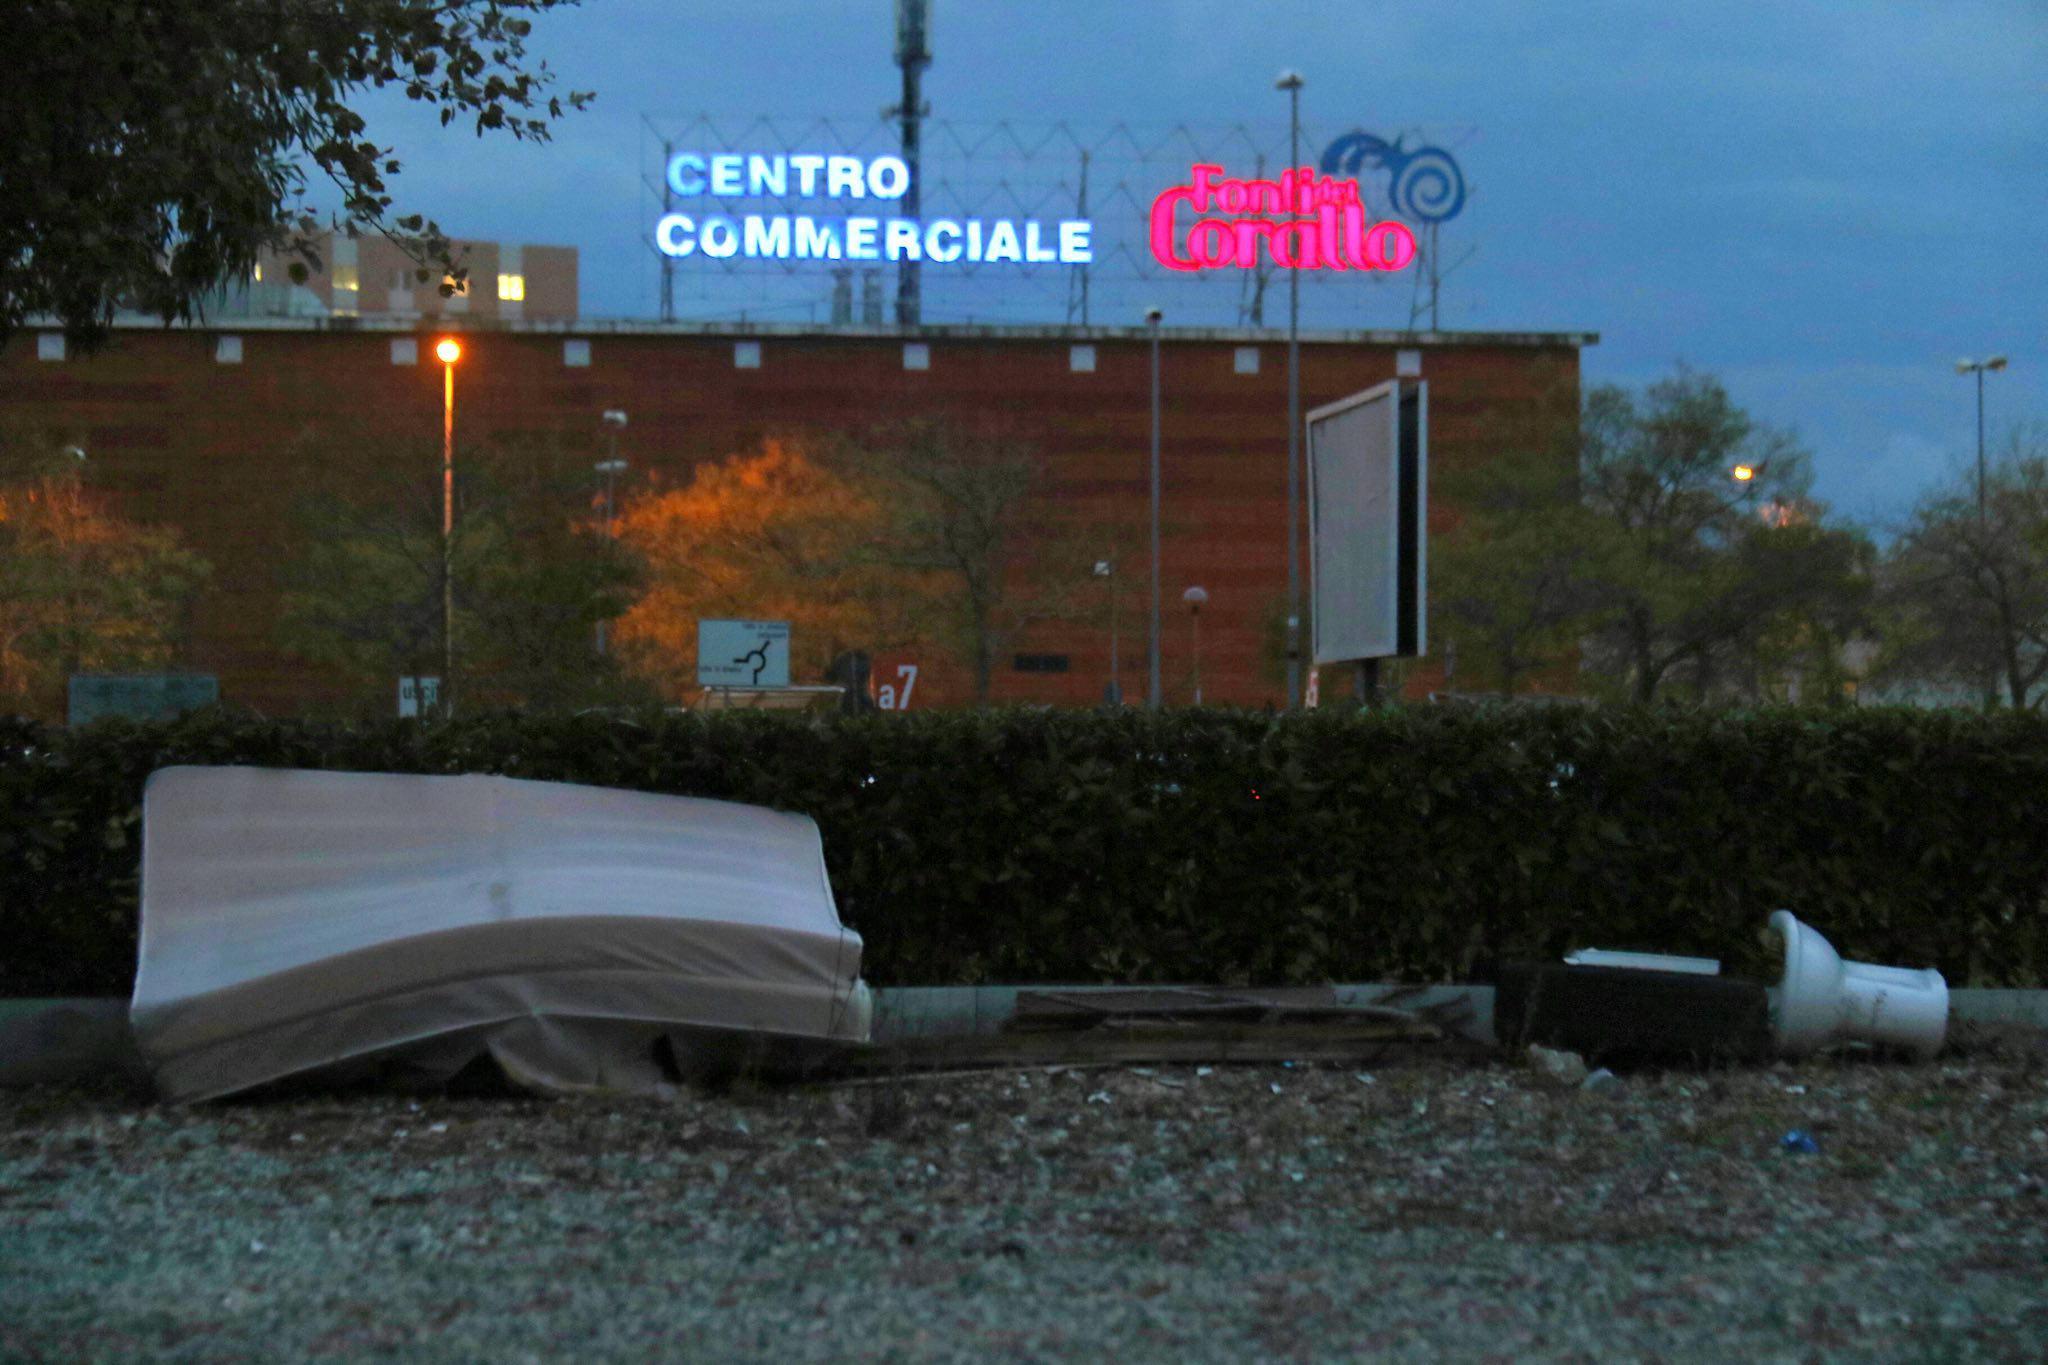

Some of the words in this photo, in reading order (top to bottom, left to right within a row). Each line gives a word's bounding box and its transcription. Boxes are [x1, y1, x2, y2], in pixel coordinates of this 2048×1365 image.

[667, 153, 910, 198] CENTRO
[1191, 164, 1315, 215] Fonti
[656, 213, 1093, 263] COMMERCIALE
[1150, 185, 1417, 272] Corallo
